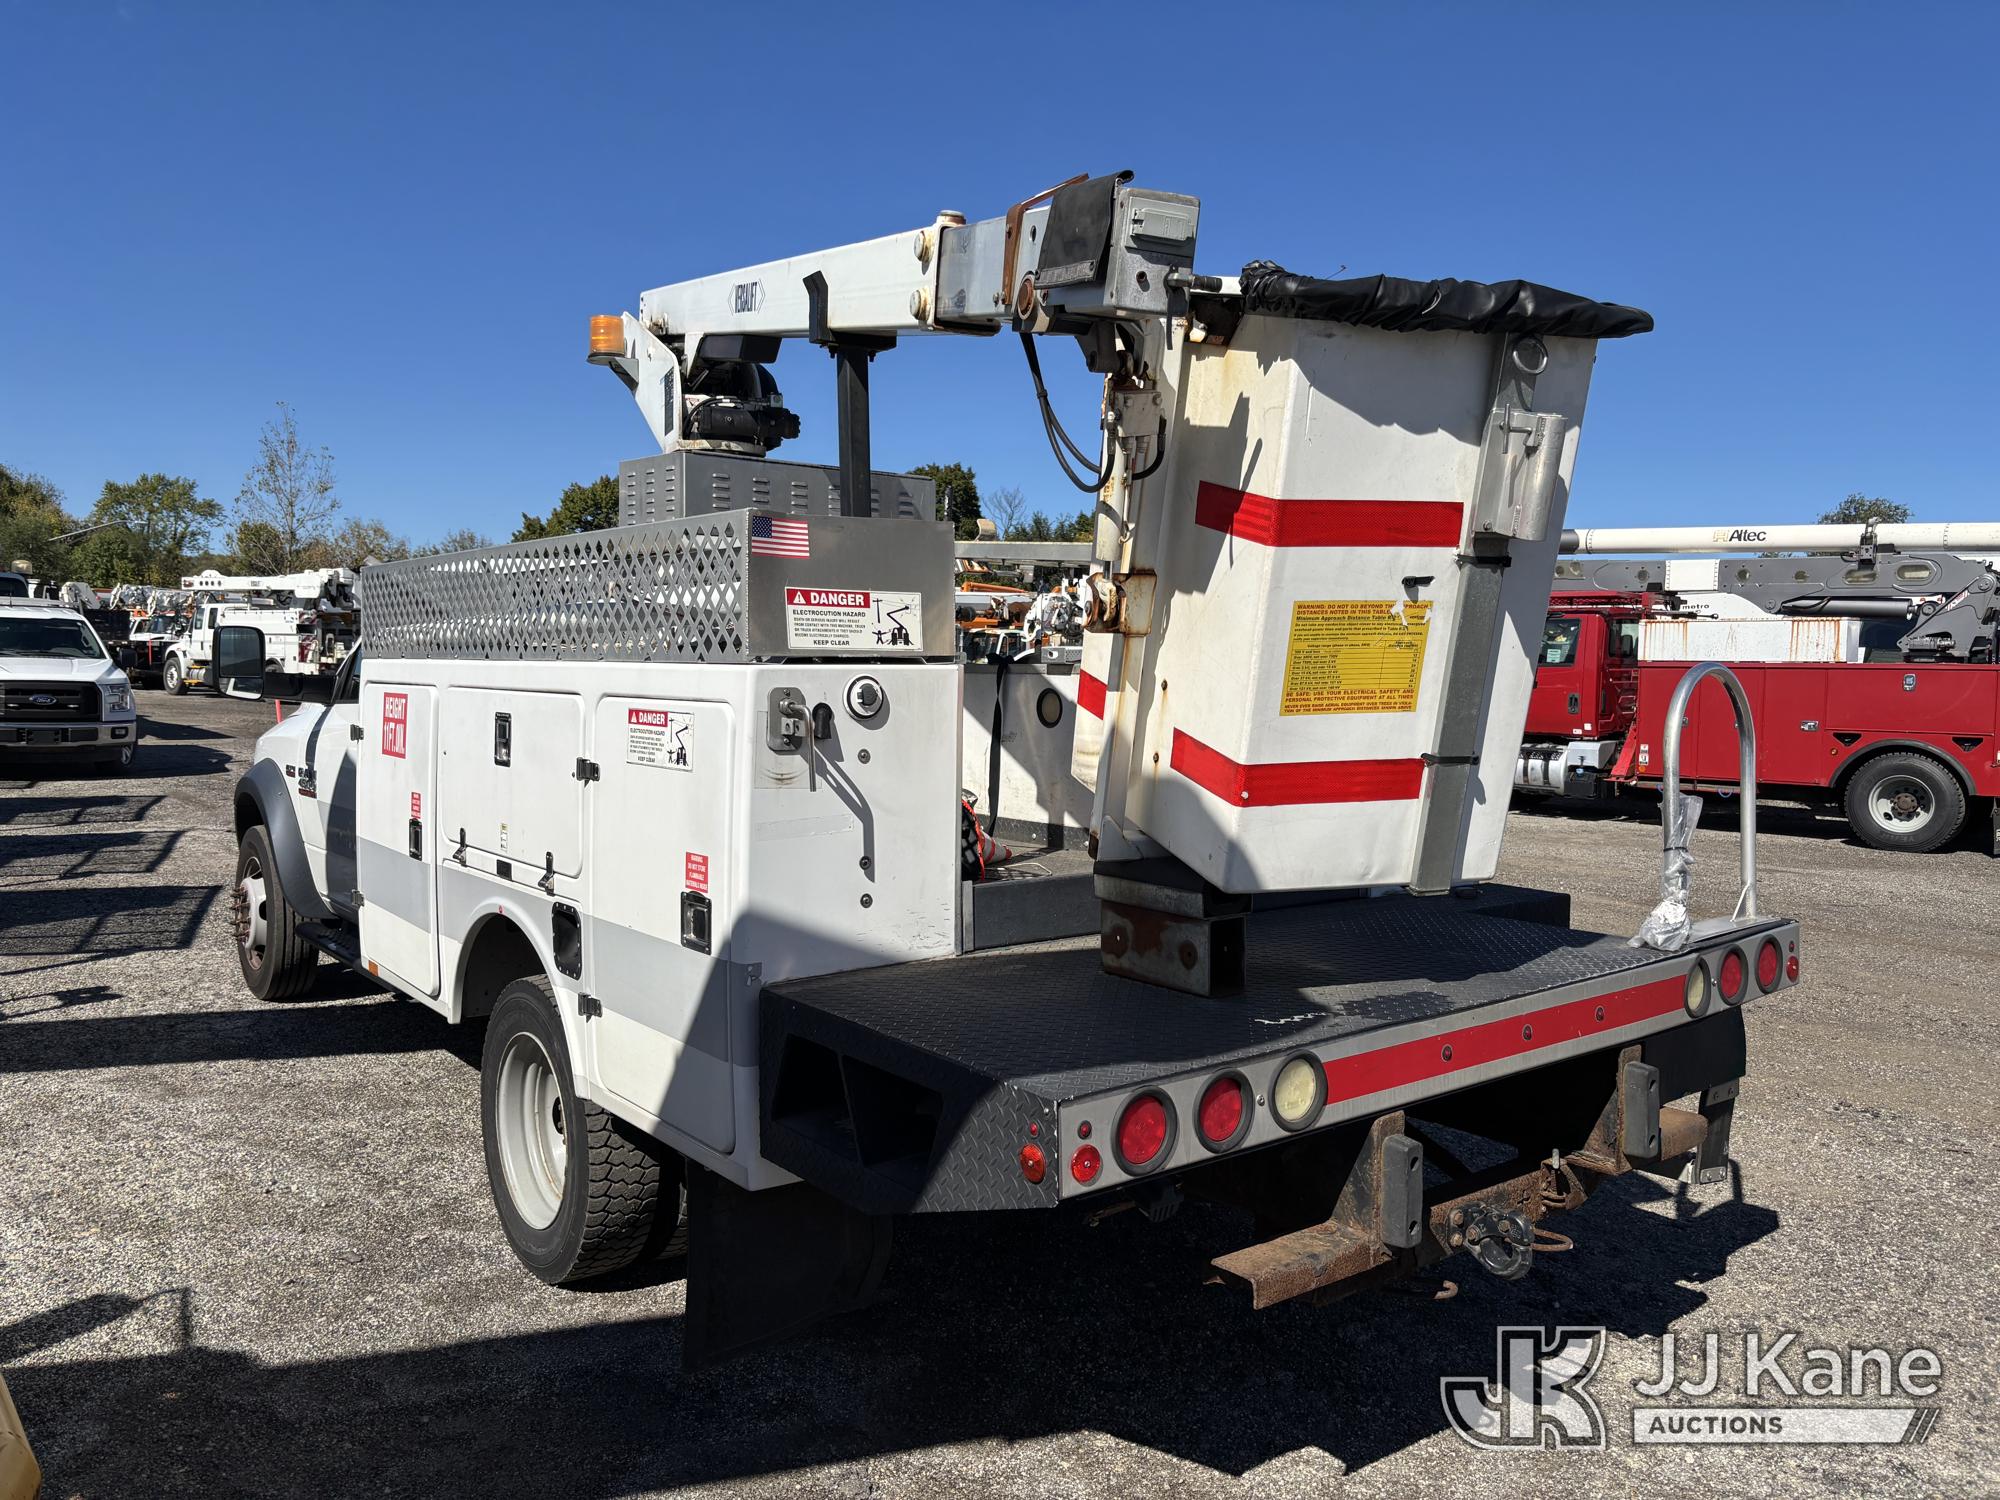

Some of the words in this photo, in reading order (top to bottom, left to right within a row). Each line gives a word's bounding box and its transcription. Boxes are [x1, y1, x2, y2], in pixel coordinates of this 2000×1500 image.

[1729, 529, 1767, 542] Altec
[810, 592, 864, 606] DANGER
[385, 697, 406, 720] HEIGHT
[639, 712, 665, 725] DANGER
